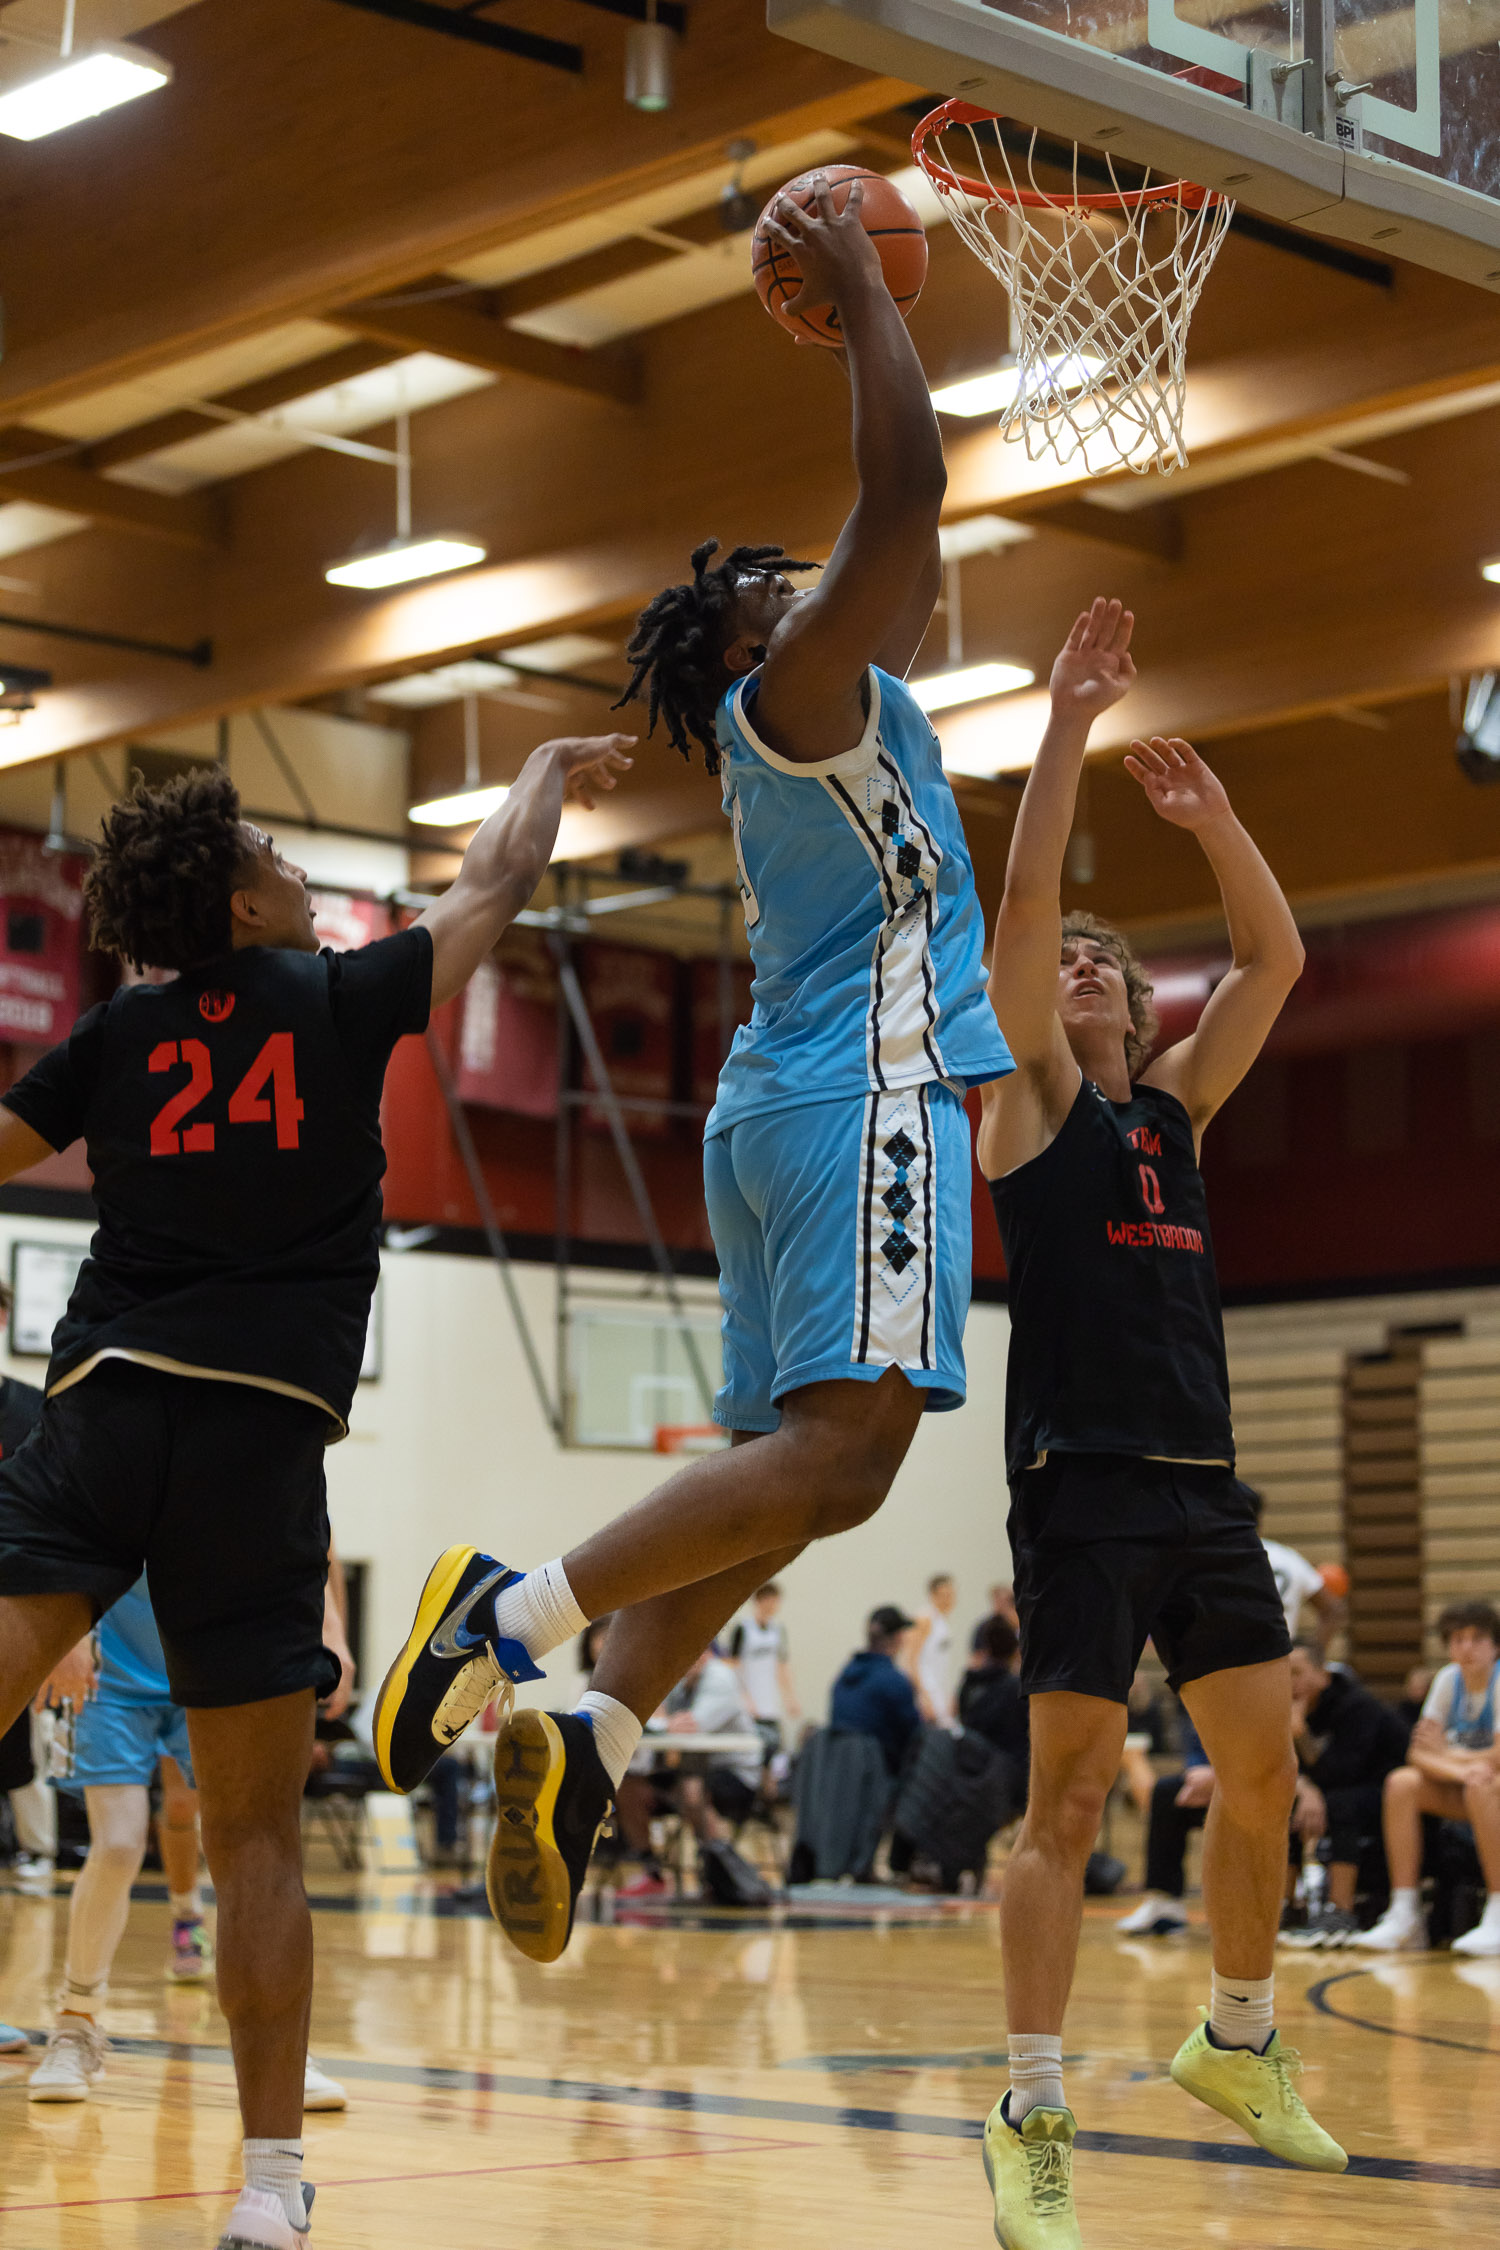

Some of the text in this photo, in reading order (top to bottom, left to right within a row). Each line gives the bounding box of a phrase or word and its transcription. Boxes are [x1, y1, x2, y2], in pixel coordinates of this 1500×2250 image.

[1335, 121, 1355, 141] BPI
[148, 1031, 305, 1157] 24
[1106, 1220, 1204, 1254] WESTBROOK
